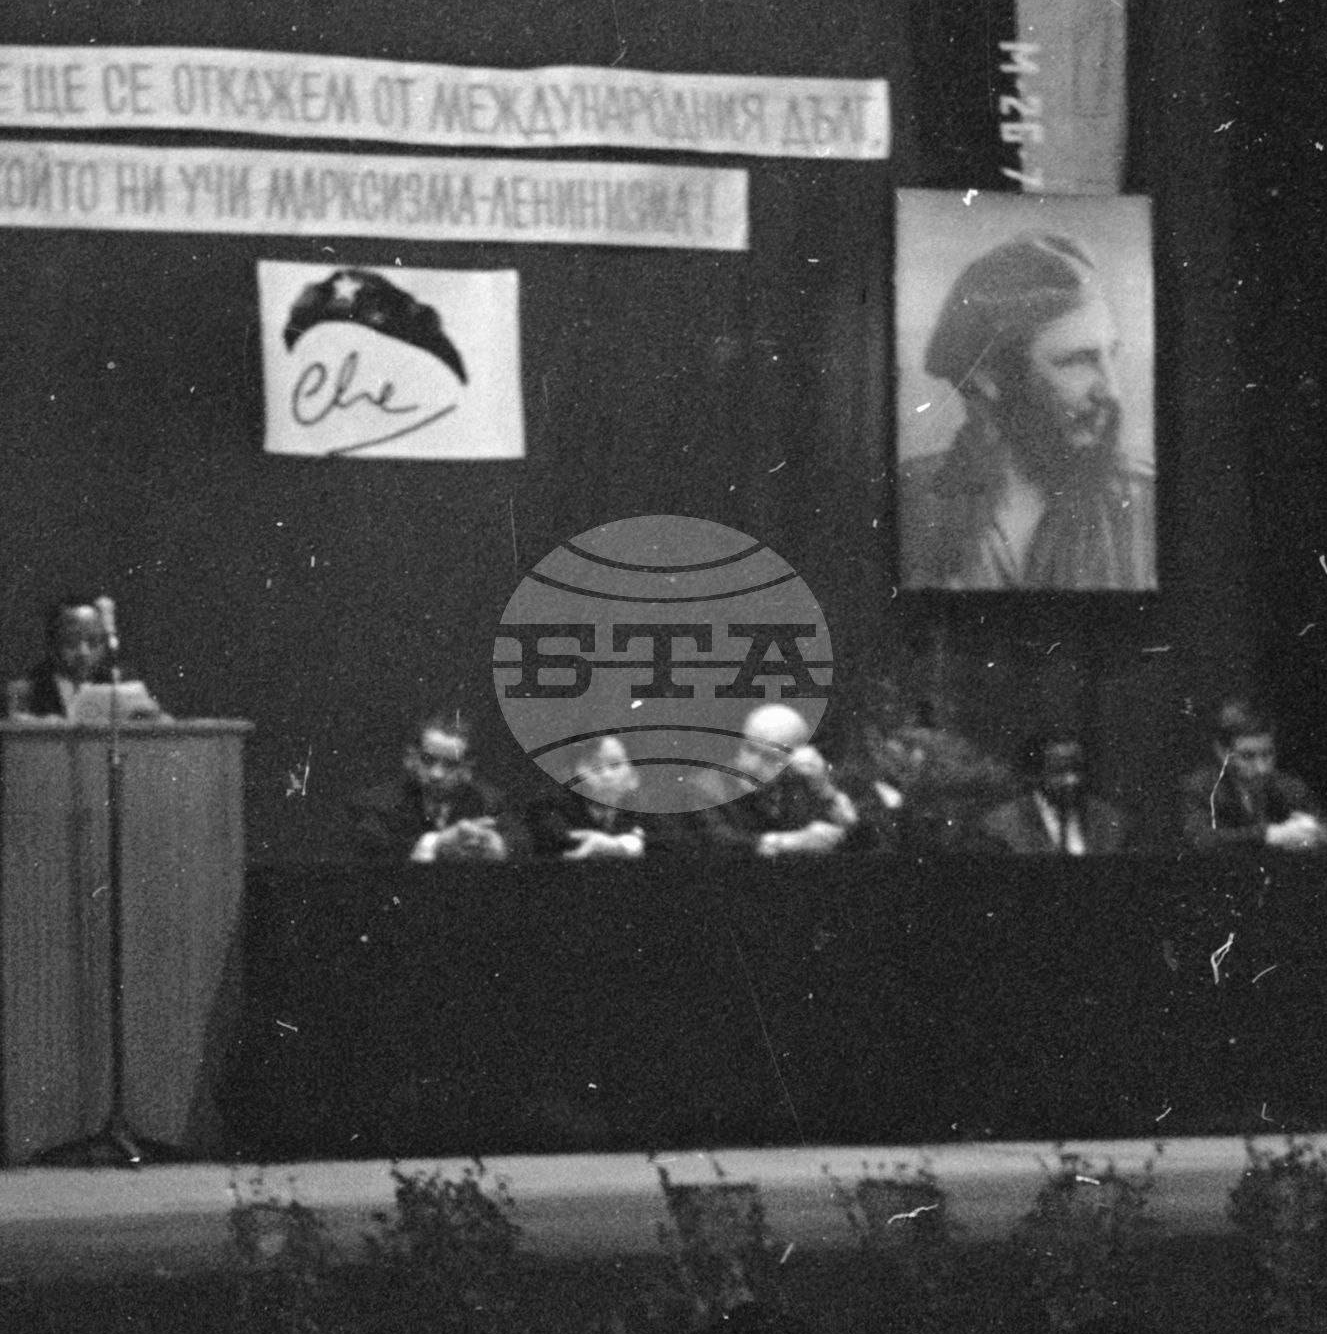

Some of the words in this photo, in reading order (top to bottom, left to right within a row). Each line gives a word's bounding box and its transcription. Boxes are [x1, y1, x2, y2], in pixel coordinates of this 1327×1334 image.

[22, 63, 88, 118] ЩЕ
[101, 62, 154, 115] СЕ
[172, 62, 361, 125] ОТКАЖЕМ
[373, 75, 416, 128] ОТ
[430, 81, 771, 142] МЕЖДУНАРОДНИЯ
[115, 161, 166, 214] НИ
[176, 164, 252, 219] УЧИ
[292, 350, 419, 426] Che
